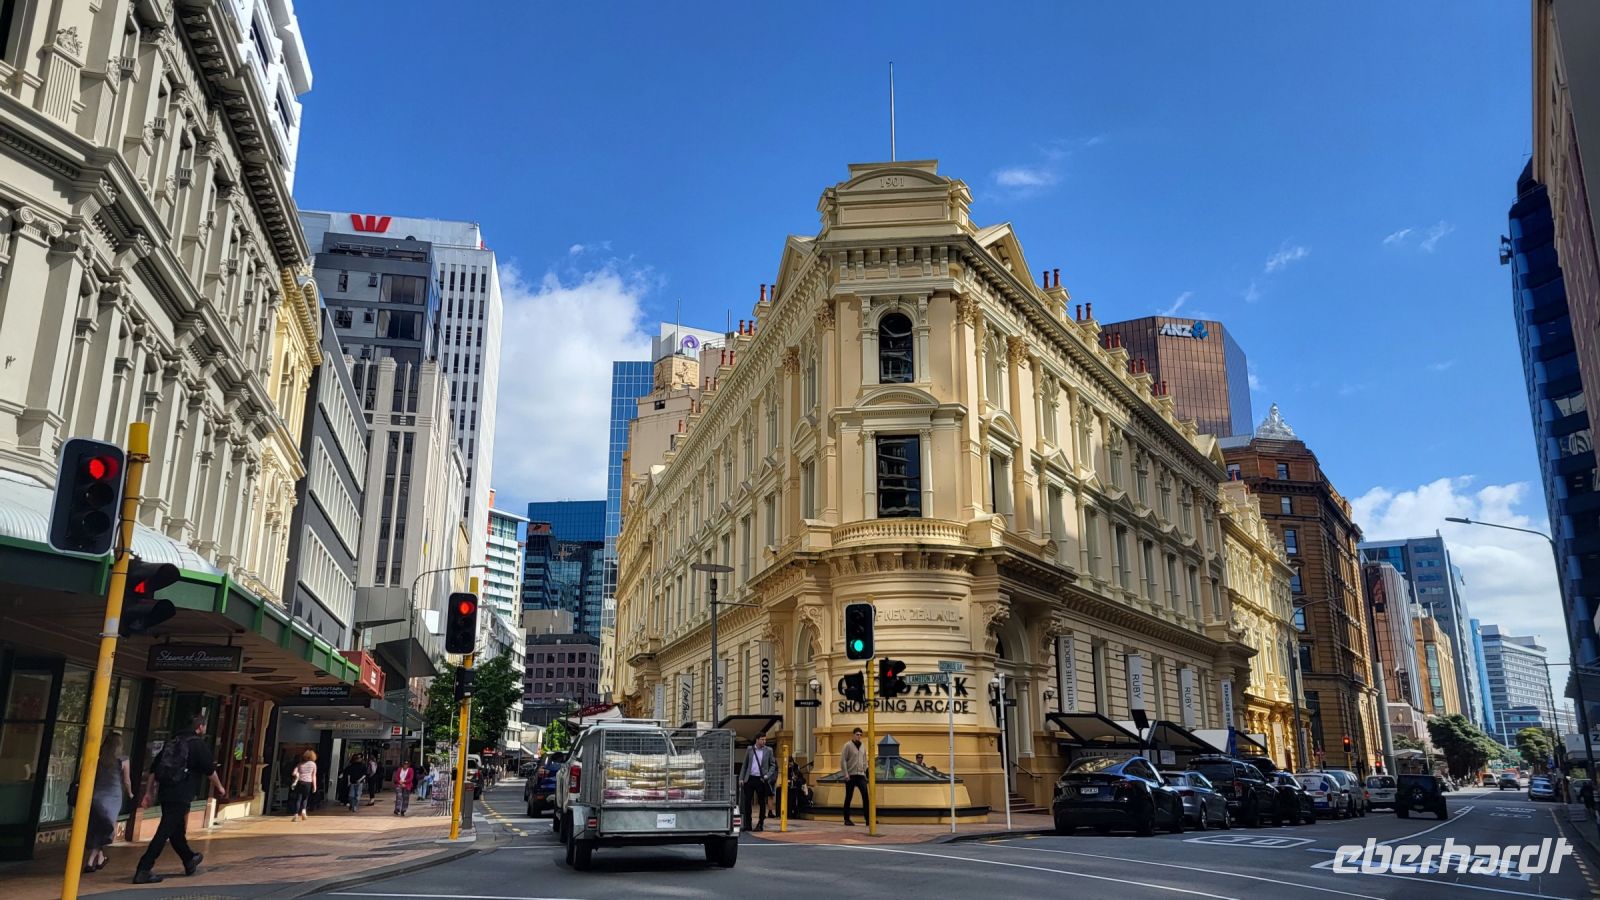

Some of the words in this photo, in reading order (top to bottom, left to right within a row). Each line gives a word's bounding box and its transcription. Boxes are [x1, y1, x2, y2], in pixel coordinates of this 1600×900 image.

[880, 176, 905, 188] 1901
[1159, 323, 1193, 337] ANZ
[884, 609, 907, 621] NEW
[1064, 639, 1072, 668] GROCER
[761, 658, 770, 698] MOJO
[1132, 673, 1141, 699] RUBY
[913, 700, 969, 713] ARCADE
[1184, 687, 1192, 709] RUBY
